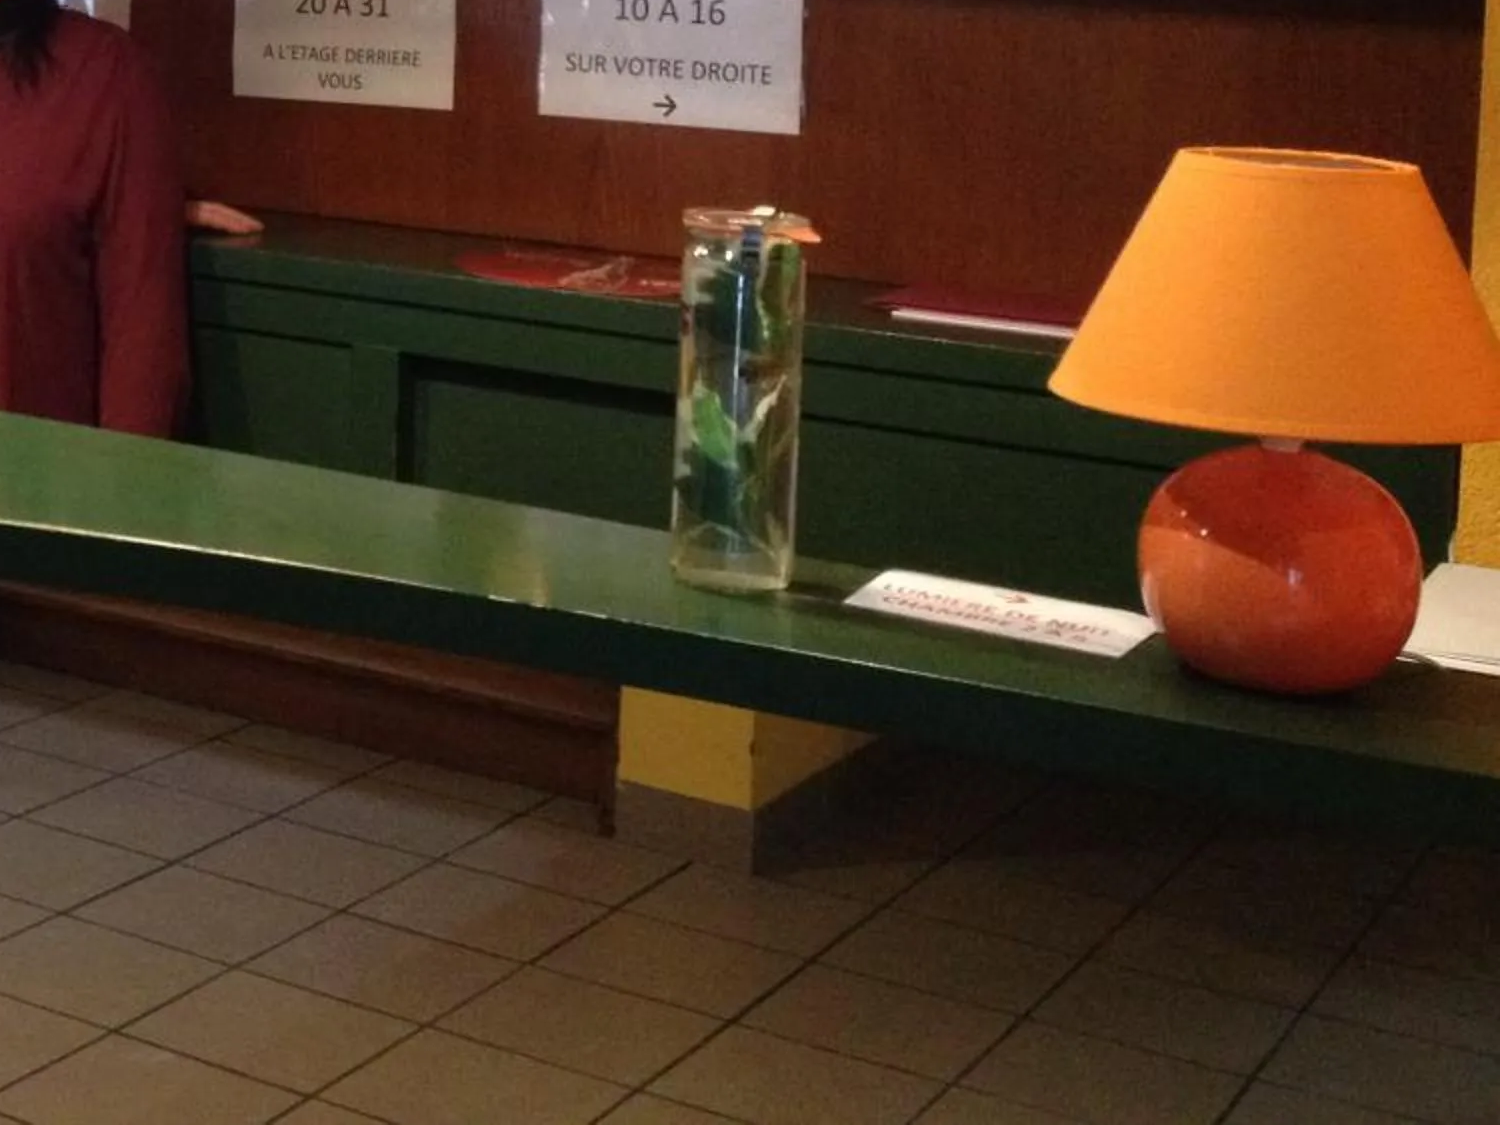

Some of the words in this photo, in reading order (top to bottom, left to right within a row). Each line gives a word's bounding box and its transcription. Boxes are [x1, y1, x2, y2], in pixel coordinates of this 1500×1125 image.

[691, 0, 726, 25] 16
[263, 43, 274, 59] A
[345, 48, 421, 67] DERRIERE
[318, 72, 362, 90] VOUS
[565, 53, 607, 73] SUR
[614, 57, 684, 79] VOTRE
[691, 61, 772, 85] DROITE
